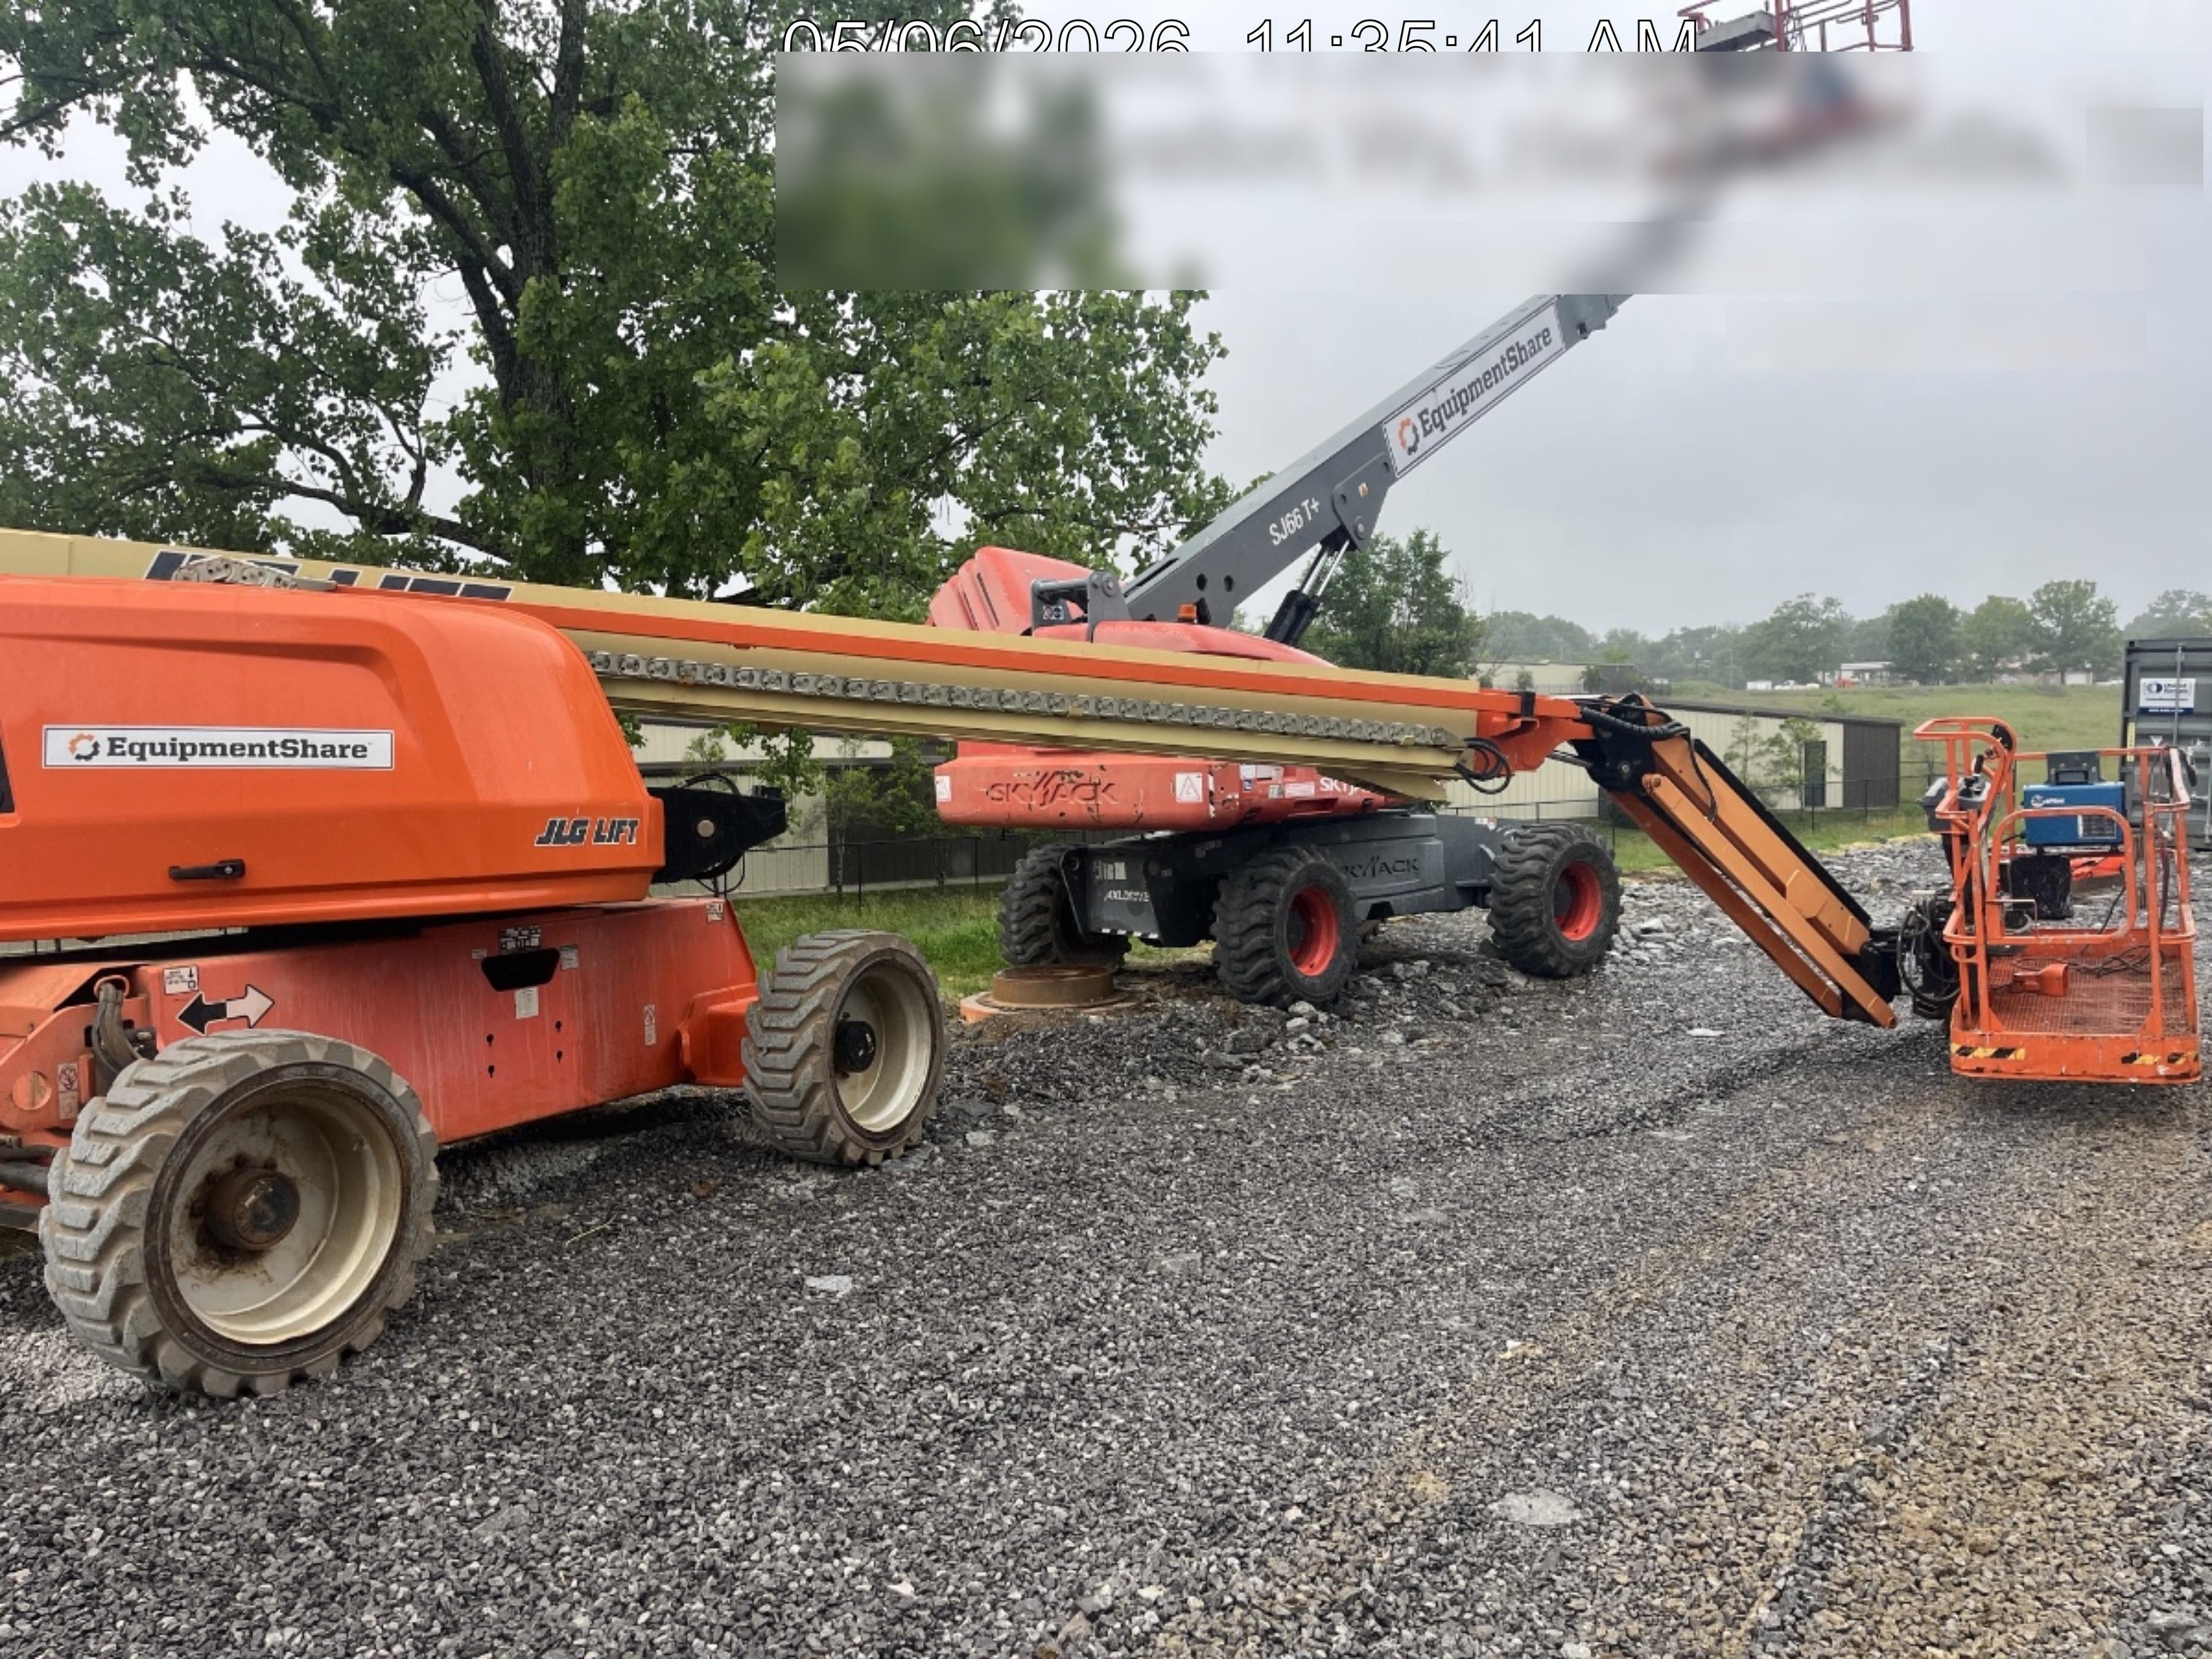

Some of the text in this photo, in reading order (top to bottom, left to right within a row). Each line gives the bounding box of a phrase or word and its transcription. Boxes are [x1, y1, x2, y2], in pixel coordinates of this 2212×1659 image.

[1418, 327, 1553, 438] EquipmentShare
[1269, 497, 1319, 546] SJ66 T+
[107, 737, 368, 762] EquipmentShare
[986, 771, 1118, 807] SKYJACK
[535, 818, 640, 846] JLG LIFT
[1341, 855, 1419, 879] KYJACK
